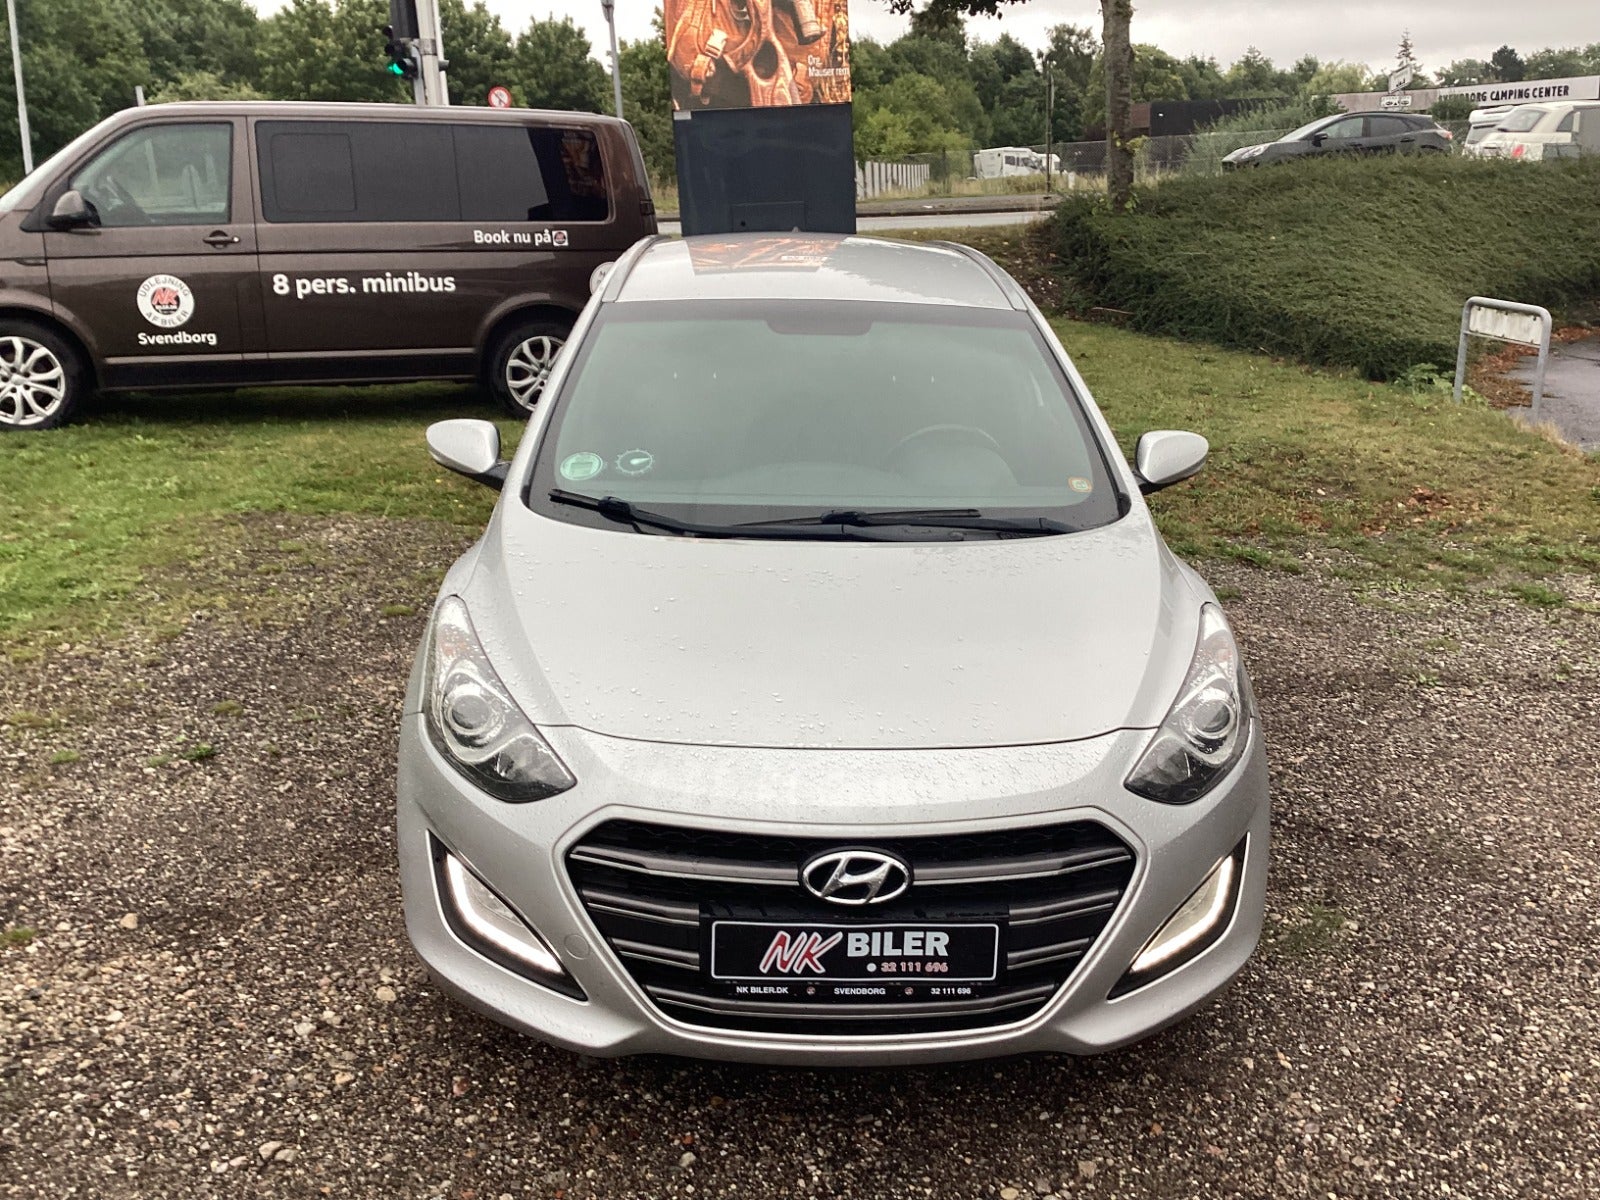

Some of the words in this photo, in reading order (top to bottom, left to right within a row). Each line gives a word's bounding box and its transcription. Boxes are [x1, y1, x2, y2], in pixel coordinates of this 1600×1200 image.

[1490, 88, 1530, 101] CAMPING
[1532, 85, 1570, 99] CENTER
[473, 229, 510, 244] Book
[513, 232, 531, 243] nu
[534, 228, 552, 246] på
[139, 277, 190, 297] UDLEJNING
[272, 273, 290, 295] 8
[296, 274, 356, 299] pers.
[362, 272, 456, 293] minibus
[146, 312, 159, 322] AF
[161, 310, 189, 325] BILER
[137, 331, 217, 346] Svendborg
[759, 930, 844, 974] NK
[847, 931, 950, 957] BILER
[881, 962, 897, 972] 32
[901, 962, 921, 972] 111
[925, 962, 949, 973] 696
[736, 986, 749, 994] NK
[750, 986, 789, 994] BILER.DK
[834, 987, 886, 995] SVENDBORG
[931, 987, 941, 995] 32
[942, 987, 956, 995] 111
[957, 987, 972, 995] 696
